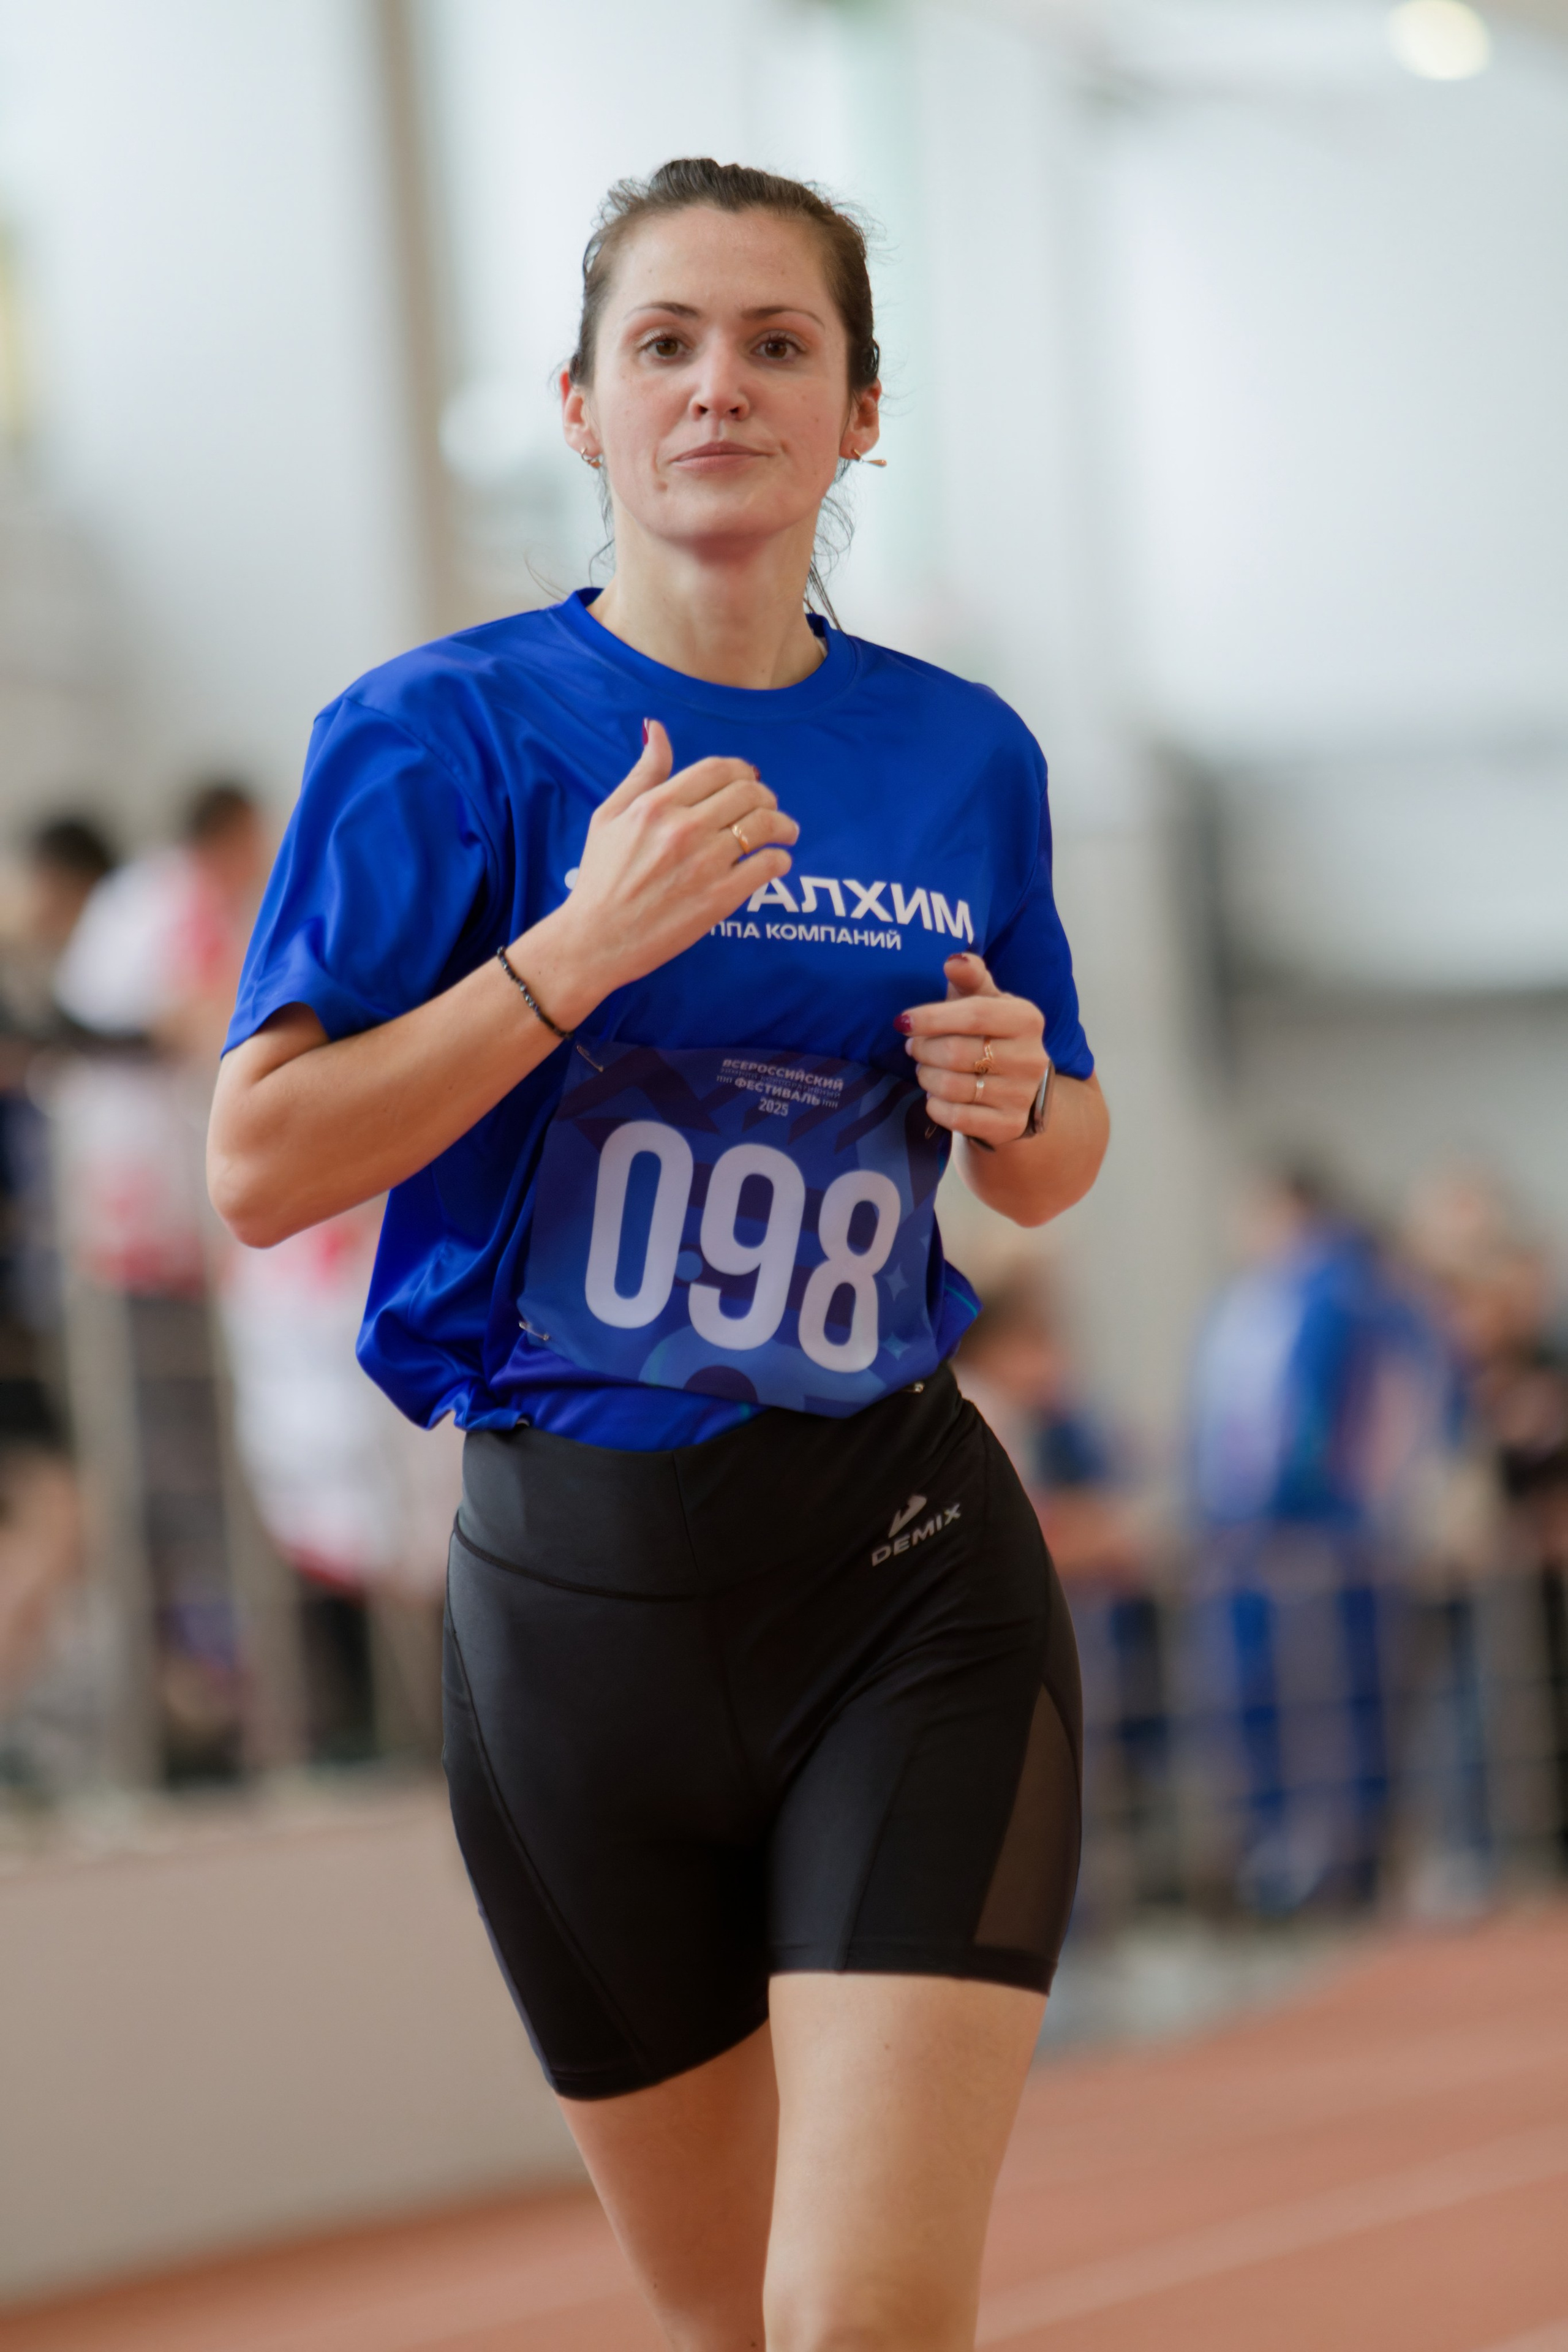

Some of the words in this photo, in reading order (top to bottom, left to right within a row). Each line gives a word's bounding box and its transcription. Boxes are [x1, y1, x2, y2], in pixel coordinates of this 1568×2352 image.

[747, 875, 974, 945] АЛХИМ
[710, 921, 761, 939] ППА
[766, 923, 902, 951] КОМПАНИЙ
[722, 1058, 844, 1091] ВСЕРОССИЙСКИЙ
[734, 1077, 821, 1106] ФЕСТИВАЛЬ
[758, 1097, 789, 1117] 2025
[584, 1120, 902, 1373] 098
[871, 1502, 961, 1567] DEMIX
